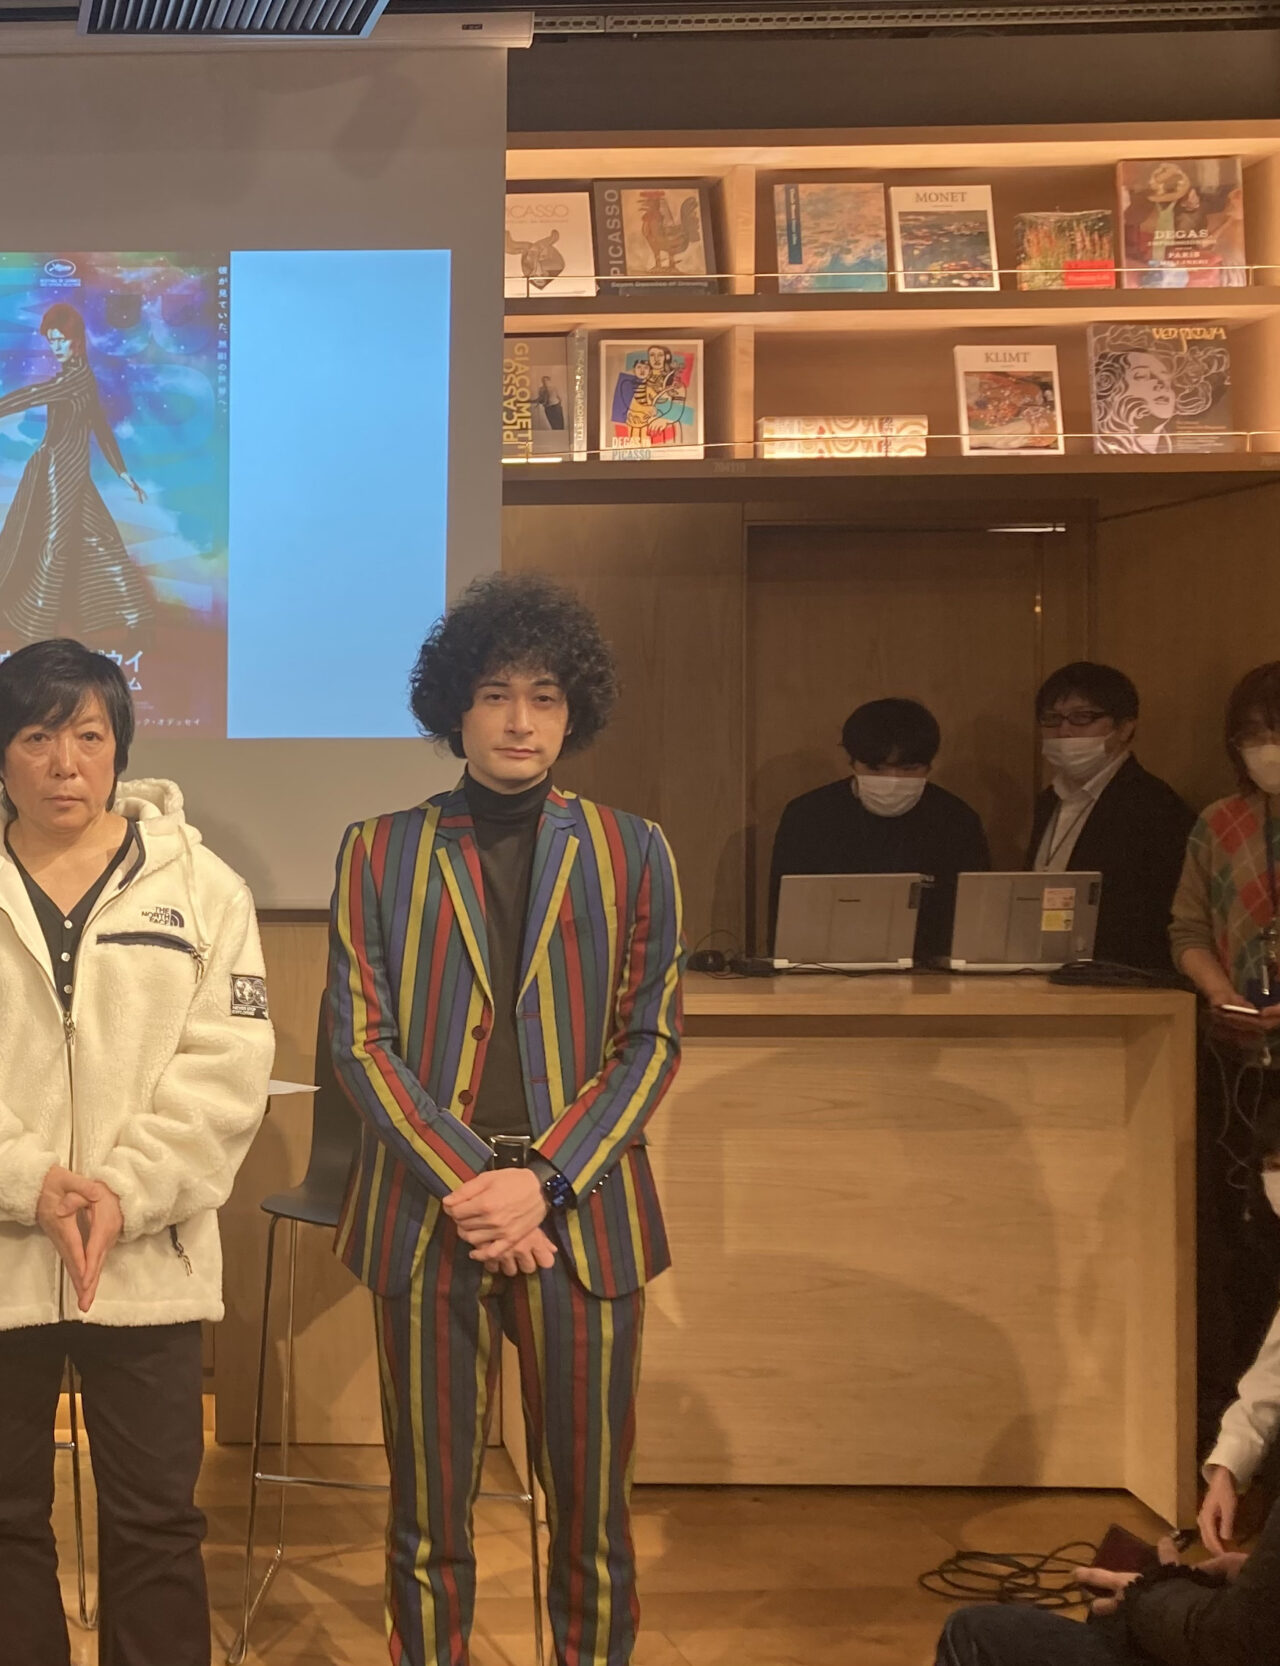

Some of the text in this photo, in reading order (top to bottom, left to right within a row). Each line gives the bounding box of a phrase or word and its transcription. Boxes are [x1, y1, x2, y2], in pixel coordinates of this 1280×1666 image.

[915, 192, 968, 203] MONET
[604, 189, 624, 276] PICASSO
[984, 351, 1030, 363] KLIMT
[502, 358, 521, 445] PICASSO
[155, 906, 169, 914] THE
[141, 911, 170, 921] NORTH
[149, 916, 170, 926] FACE
